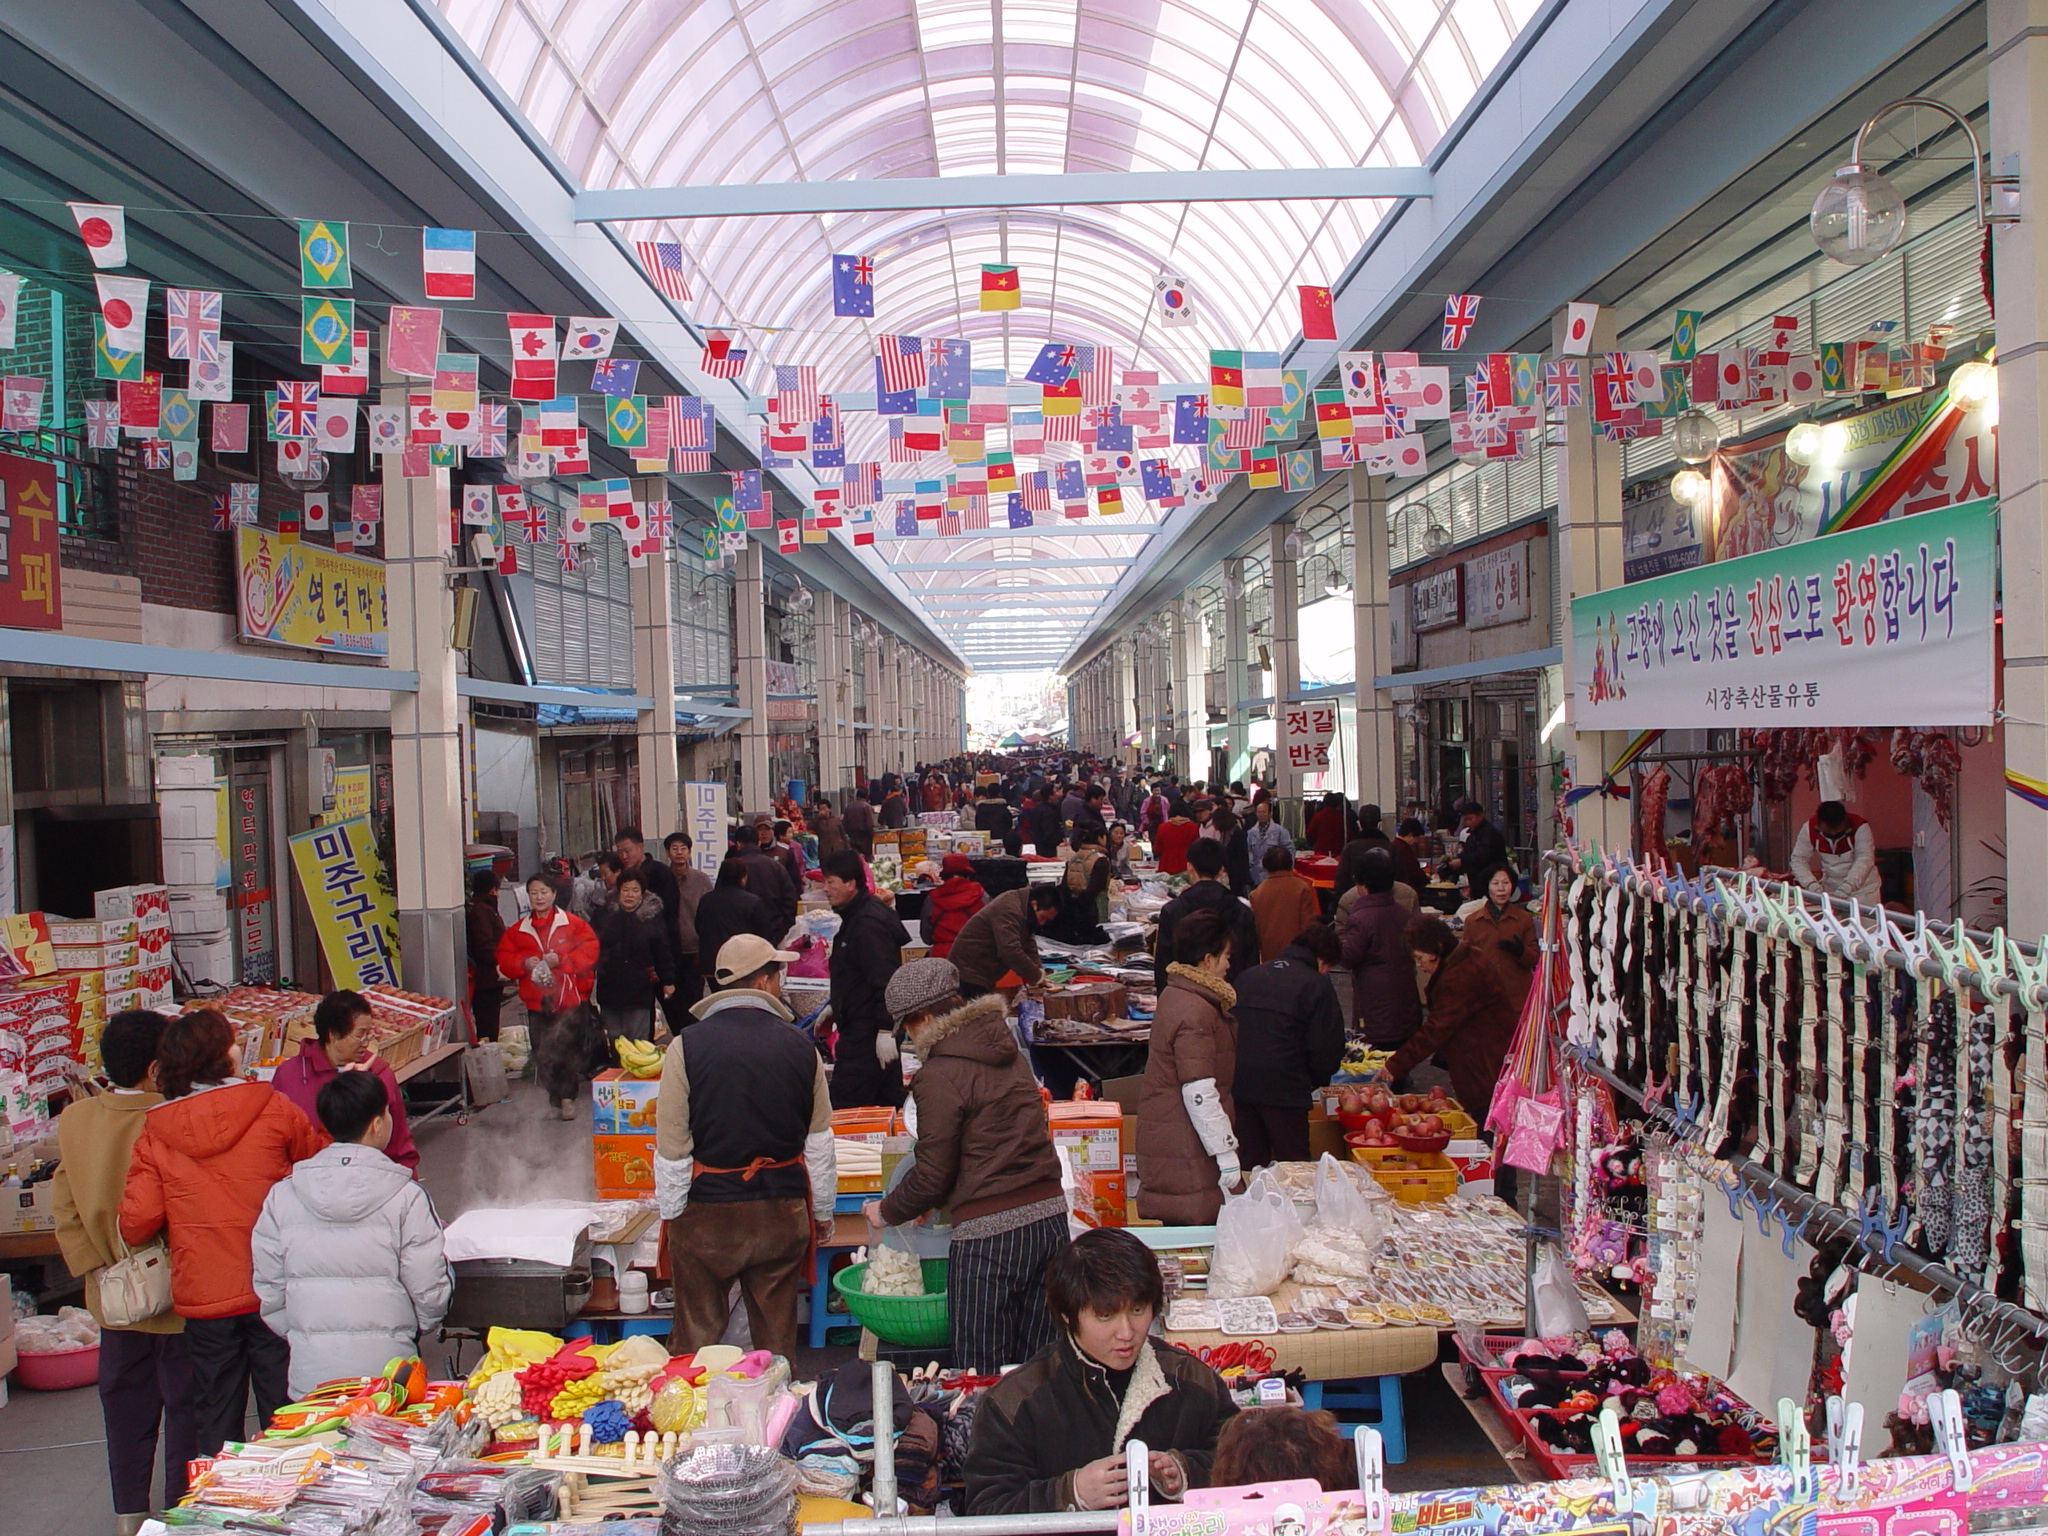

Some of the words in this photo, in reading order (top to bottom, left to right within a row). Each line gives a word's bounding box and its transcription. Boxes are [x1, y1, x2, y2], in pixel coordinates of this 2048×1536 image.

[18, 479, 54, 615] 수퍼
[1626, 601, 1666, 670] 고향에
[1671, 593, 1701, 662] 오신
[1707, 586, 1741, 663] 것을
[1747, 575, 1824, 656] 진심으로
[1832, 540, 1959, 646] 환영합니다
[1286, 708, 1335, 735] 젓갈
[1705, 682, 1821, 711] 시장축산물유통
